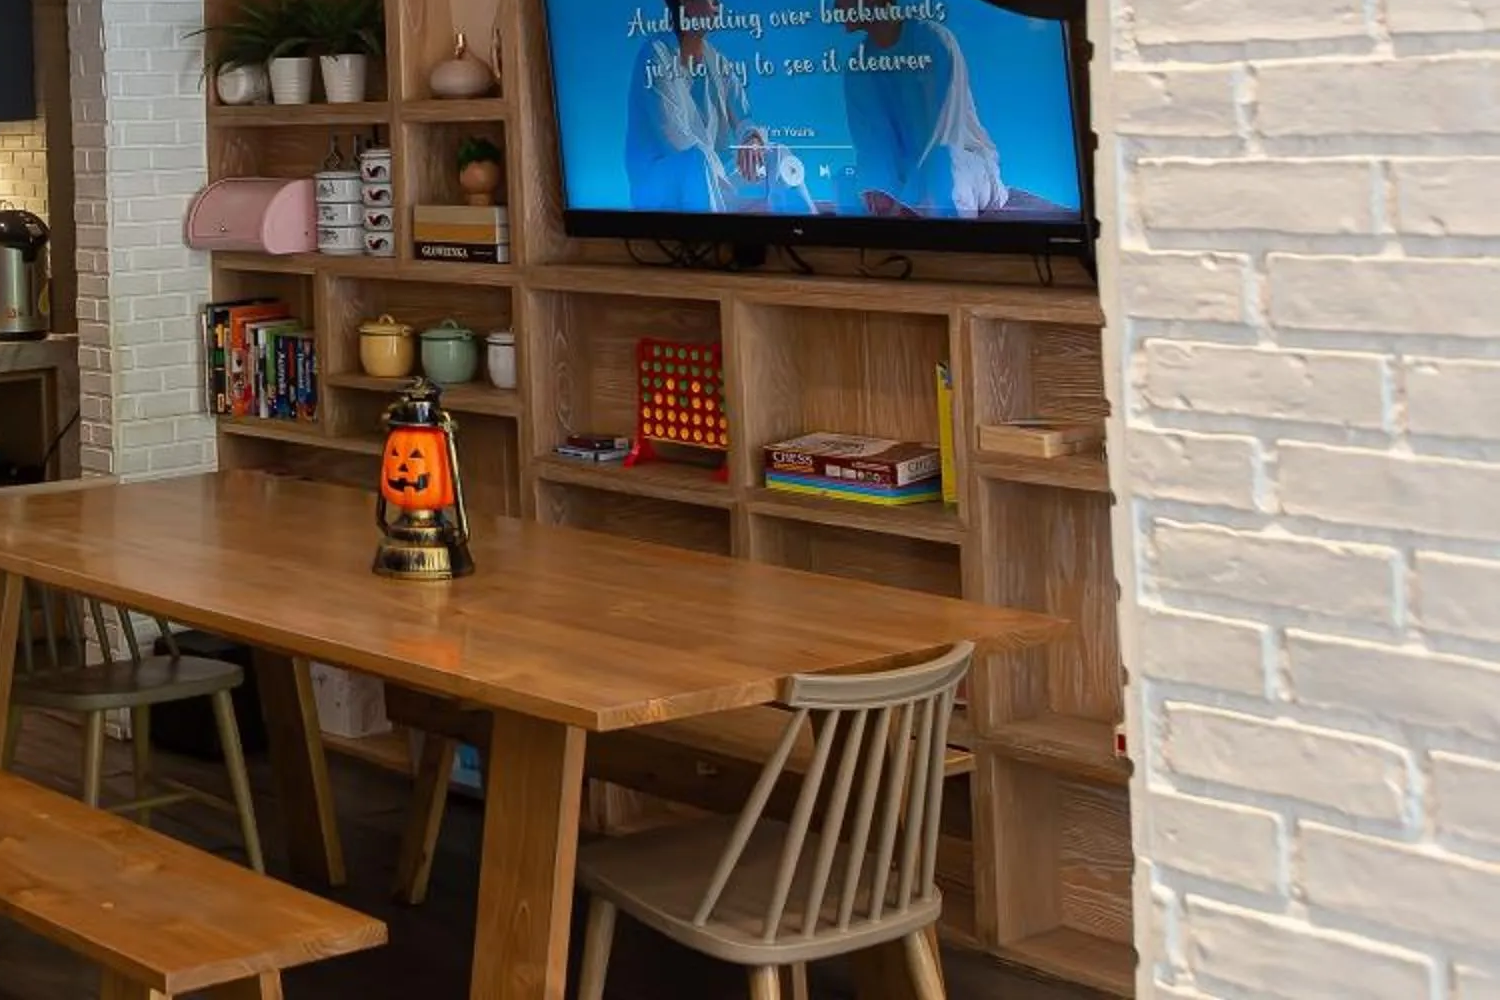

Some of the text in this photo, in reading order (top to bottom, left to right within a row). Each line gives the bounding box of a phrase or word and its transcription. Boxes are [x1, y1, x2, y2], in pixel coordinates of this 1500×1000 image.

[627, 7, 675, 37] And
[679, 2, 763, 38] bending
[769, 9, 813, 27] over
[645, 43, 933, 89] just to try to see it clearer
